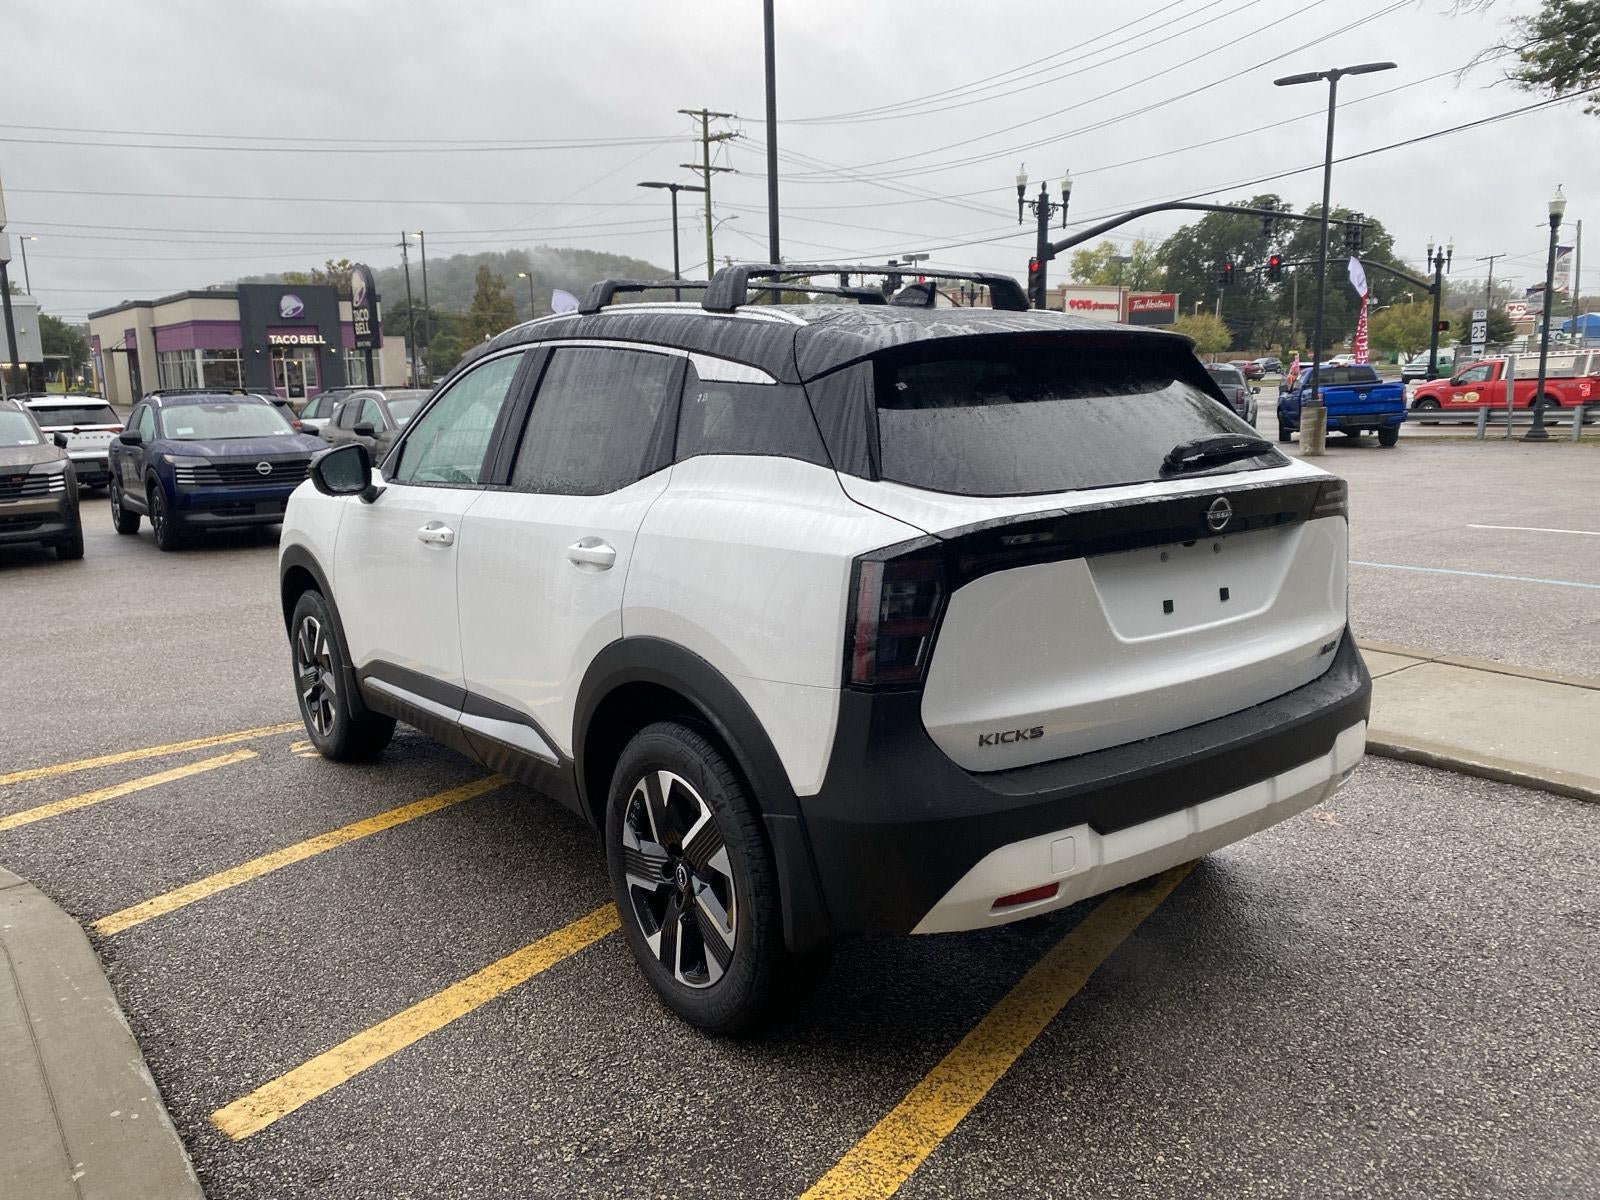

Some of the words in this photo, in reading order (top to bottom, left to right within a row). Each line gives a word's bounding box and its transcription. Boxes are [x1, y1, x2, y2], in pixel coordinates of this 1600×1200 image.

[1133, 300, 1145, 310] Tim
[1146, 299, 1171, 309] Hortons
[353, 309, 369, 321] TACO
[355, 322, 371, 335] BELL
[1472, 326, 1486, 339] 25
[269, 335, 299, 344] TACO
[300, 335, 326, 344] BELL
[979, 725, 1044, 747] KICKS
